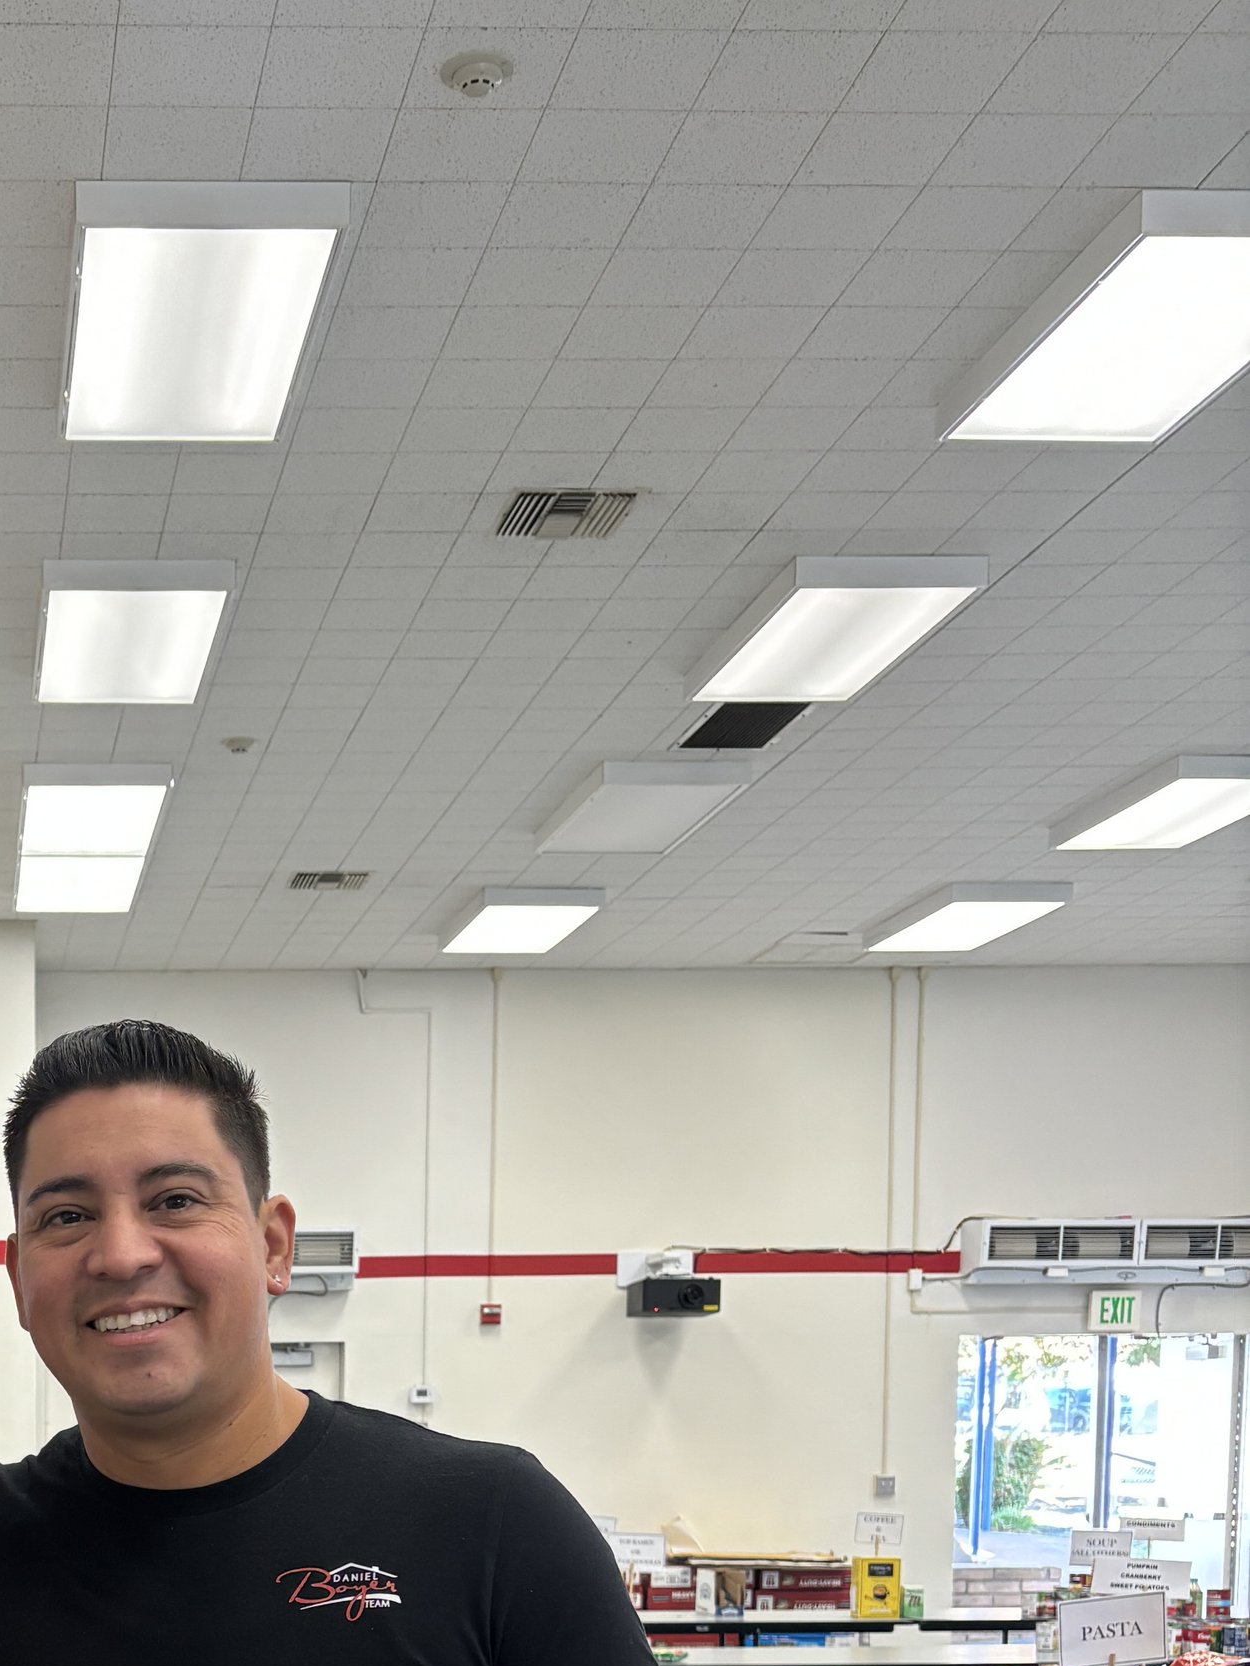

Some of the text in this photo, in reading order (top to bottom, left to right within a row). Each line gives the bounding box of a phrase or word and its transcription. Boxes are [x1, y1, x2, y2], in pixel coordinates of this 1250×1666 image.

[1099, 1297, 1136, 1325] EXIT
[1126, 1520, 1176, 1528] CONDIMENTS
[1086, 1537, 1118, 1548] SOUP
[333, 1572, 379, 1583] DANIEL
[1120, 1572, 1162, 1581] CRANBERRY
[1110, 1582, 1133, 1590] SWEET
[275, 1567, 397, 1621] Boyer
[364, 1600, 391, 1608] TEAM
[1081, 1621, 1143, 1641] PASTA
